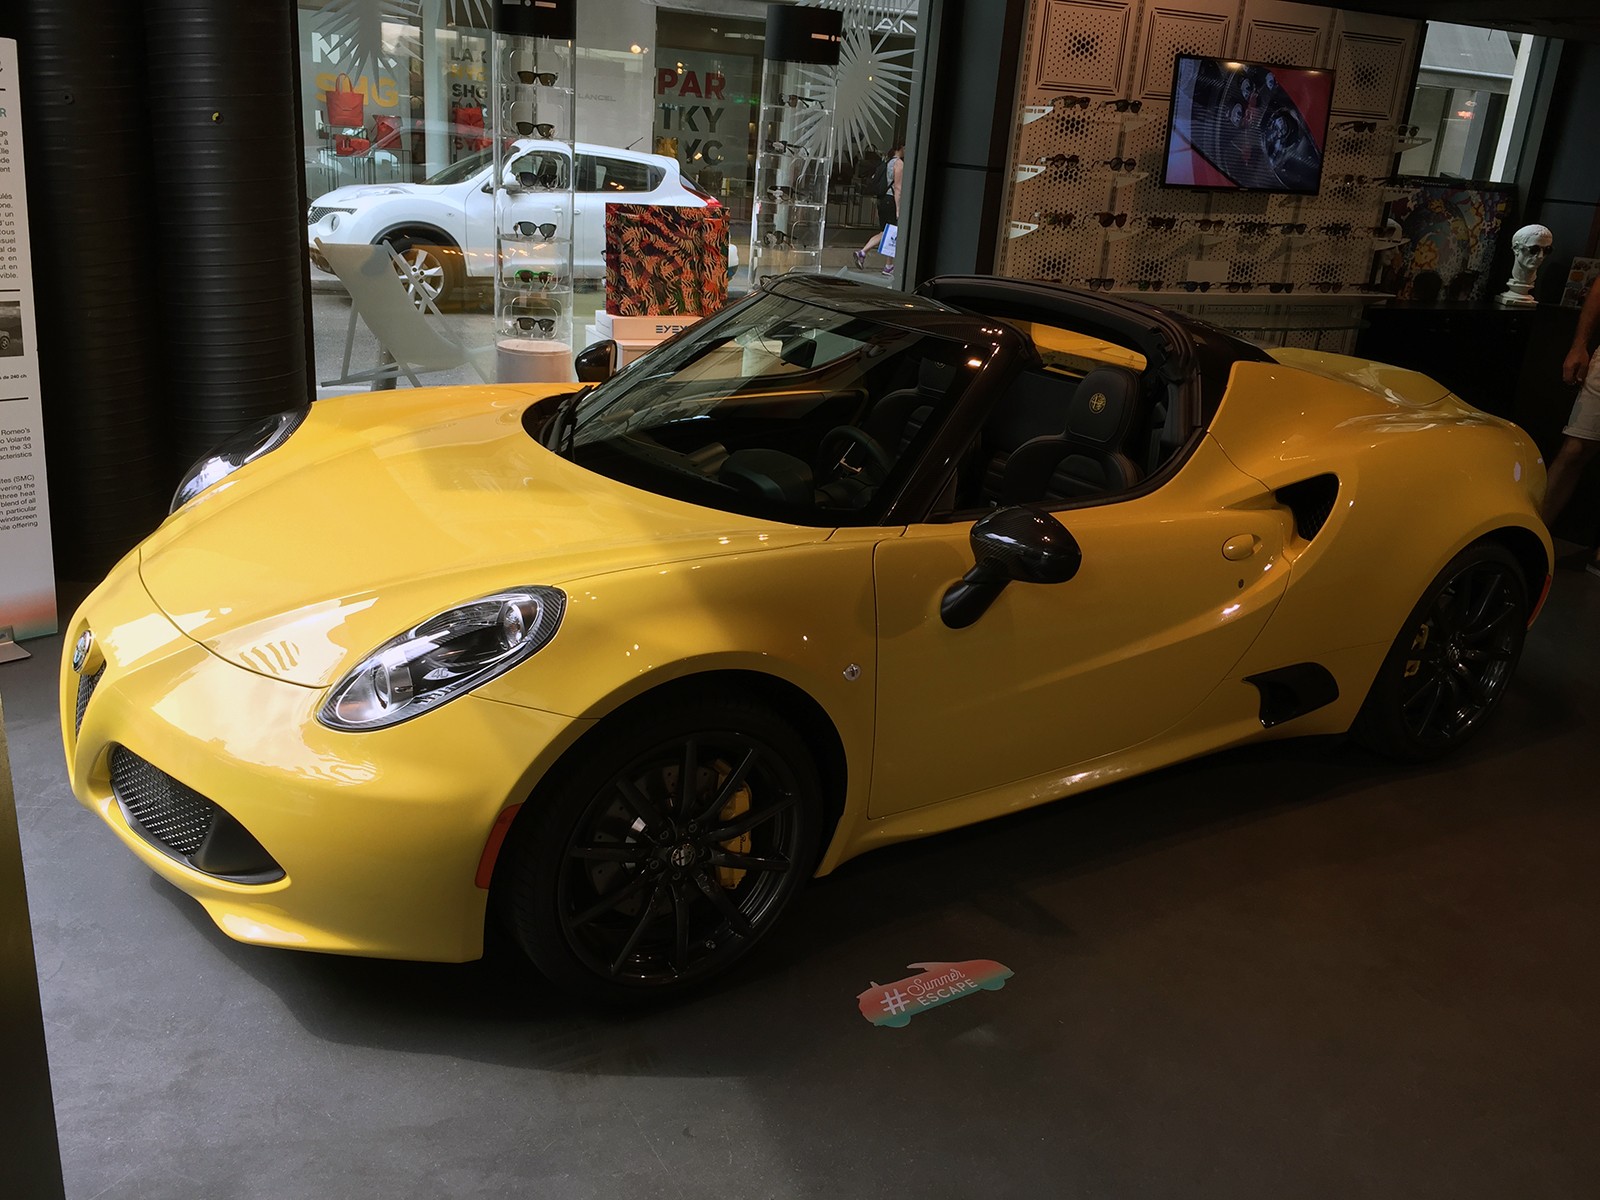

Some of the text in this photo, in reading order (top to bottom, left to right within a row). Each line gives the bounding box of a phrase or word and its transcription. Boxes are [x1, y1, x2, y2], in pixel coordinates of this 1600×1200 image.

[657, 68, 726, 100] PAR
[452, 83, 488, 99] SHG
[578, 93, 617, 102] LANCEL
[658, 105, 725, 133] TKY
[657, 137, 723, 165] YC
[1, 427, 31, 436] Romeo's
[13, 474, 35, 484] (SMC)
[6, 505, 37, 516] particular
[12, 521, 39, 530] offering
[916, 978, 979, 1007] ESCAPE
